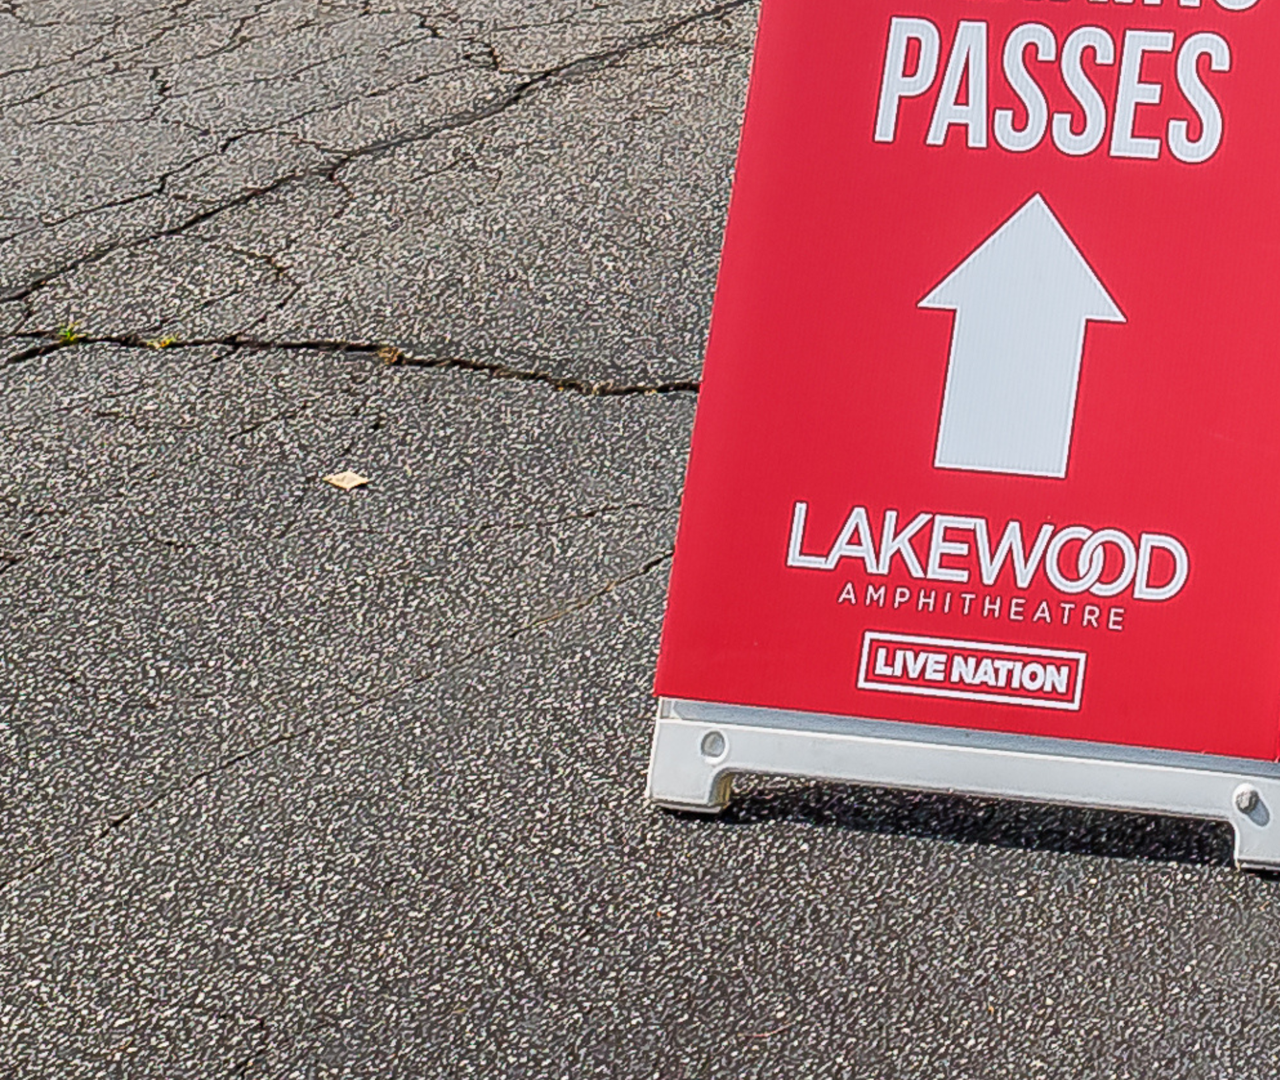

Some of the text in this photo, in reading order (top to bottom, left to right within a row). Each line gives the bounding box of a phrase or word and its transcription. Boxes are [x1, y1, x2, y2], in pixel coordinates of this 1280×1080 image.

[873, 16, 1231, 162] PASSES
[786, 502, 1190, 601] LAKEWOOD
[837, 582, 1126, 631] AMPHITHEATRE
[873, 647, 1070, 695] LIVE NATION
